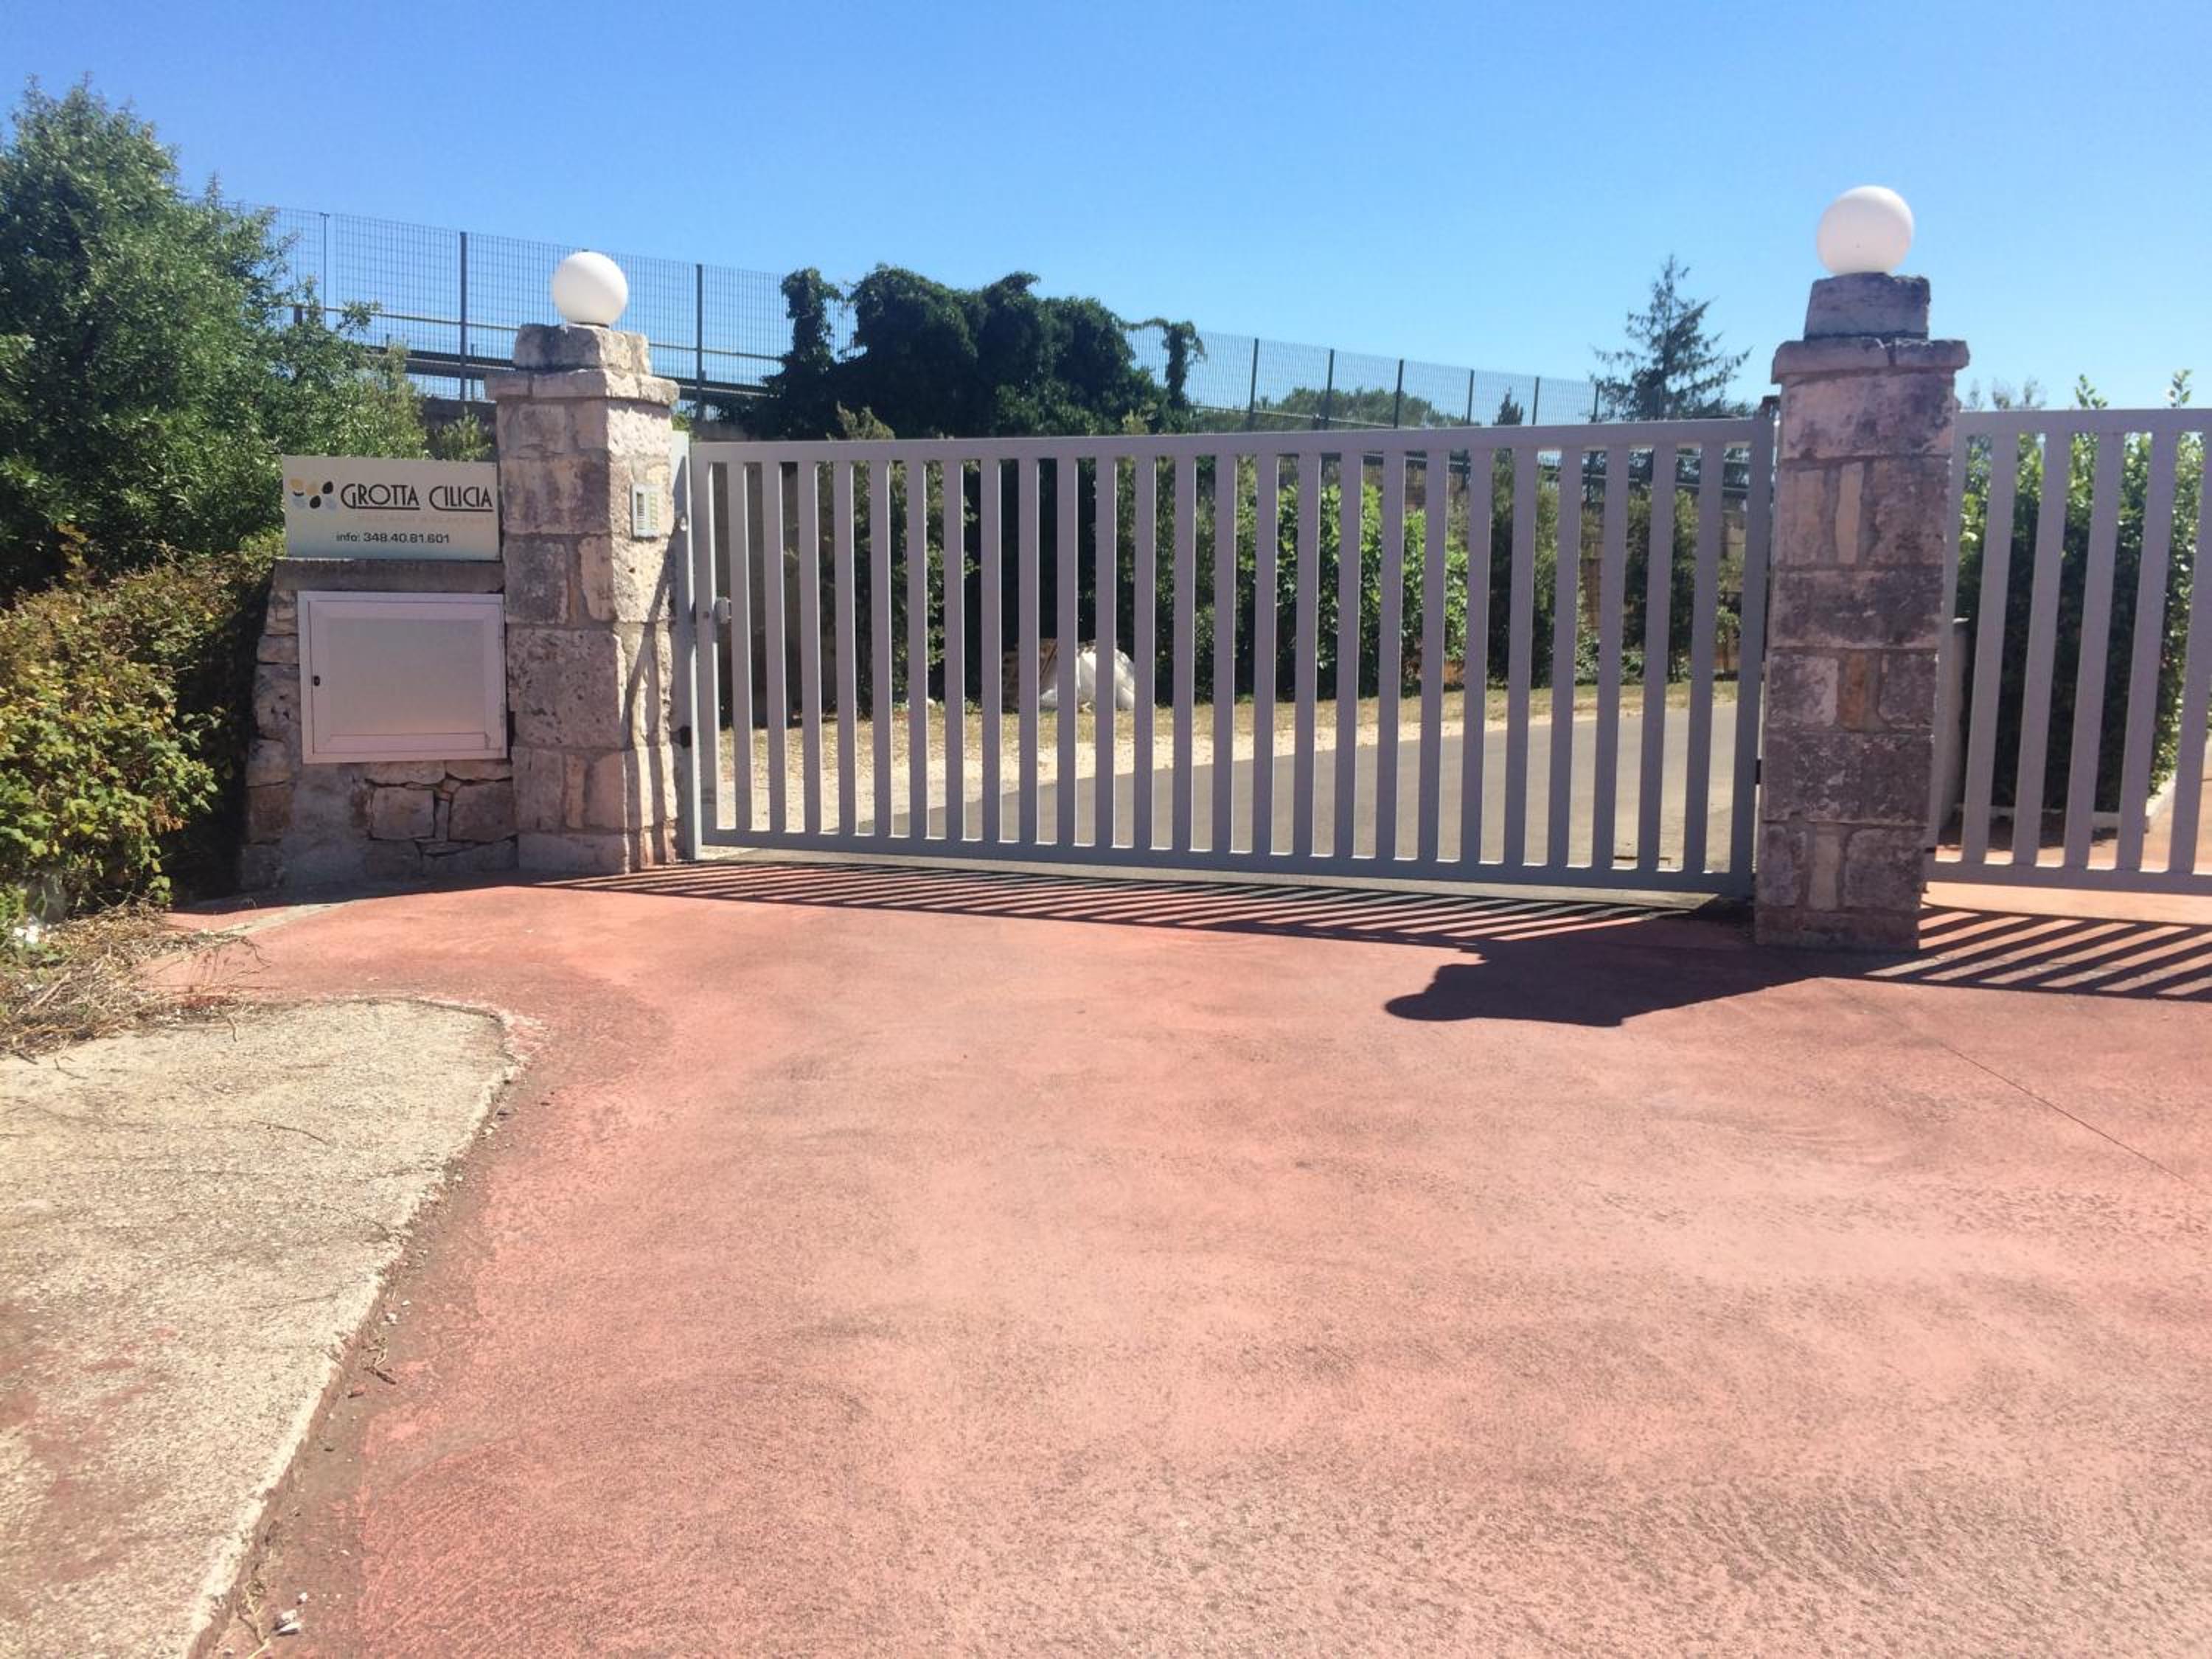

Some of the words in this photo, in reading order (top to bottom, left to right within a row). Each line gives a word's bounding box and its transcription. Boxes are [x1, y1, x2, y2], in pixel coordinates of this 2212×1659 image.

[341, 484, 420, 510] GROTTA
[429, 486, 493, 512] CILICIA
[336, 532, 360, 542] info:
[363, 533, 450, 543] 348.40.81.601
